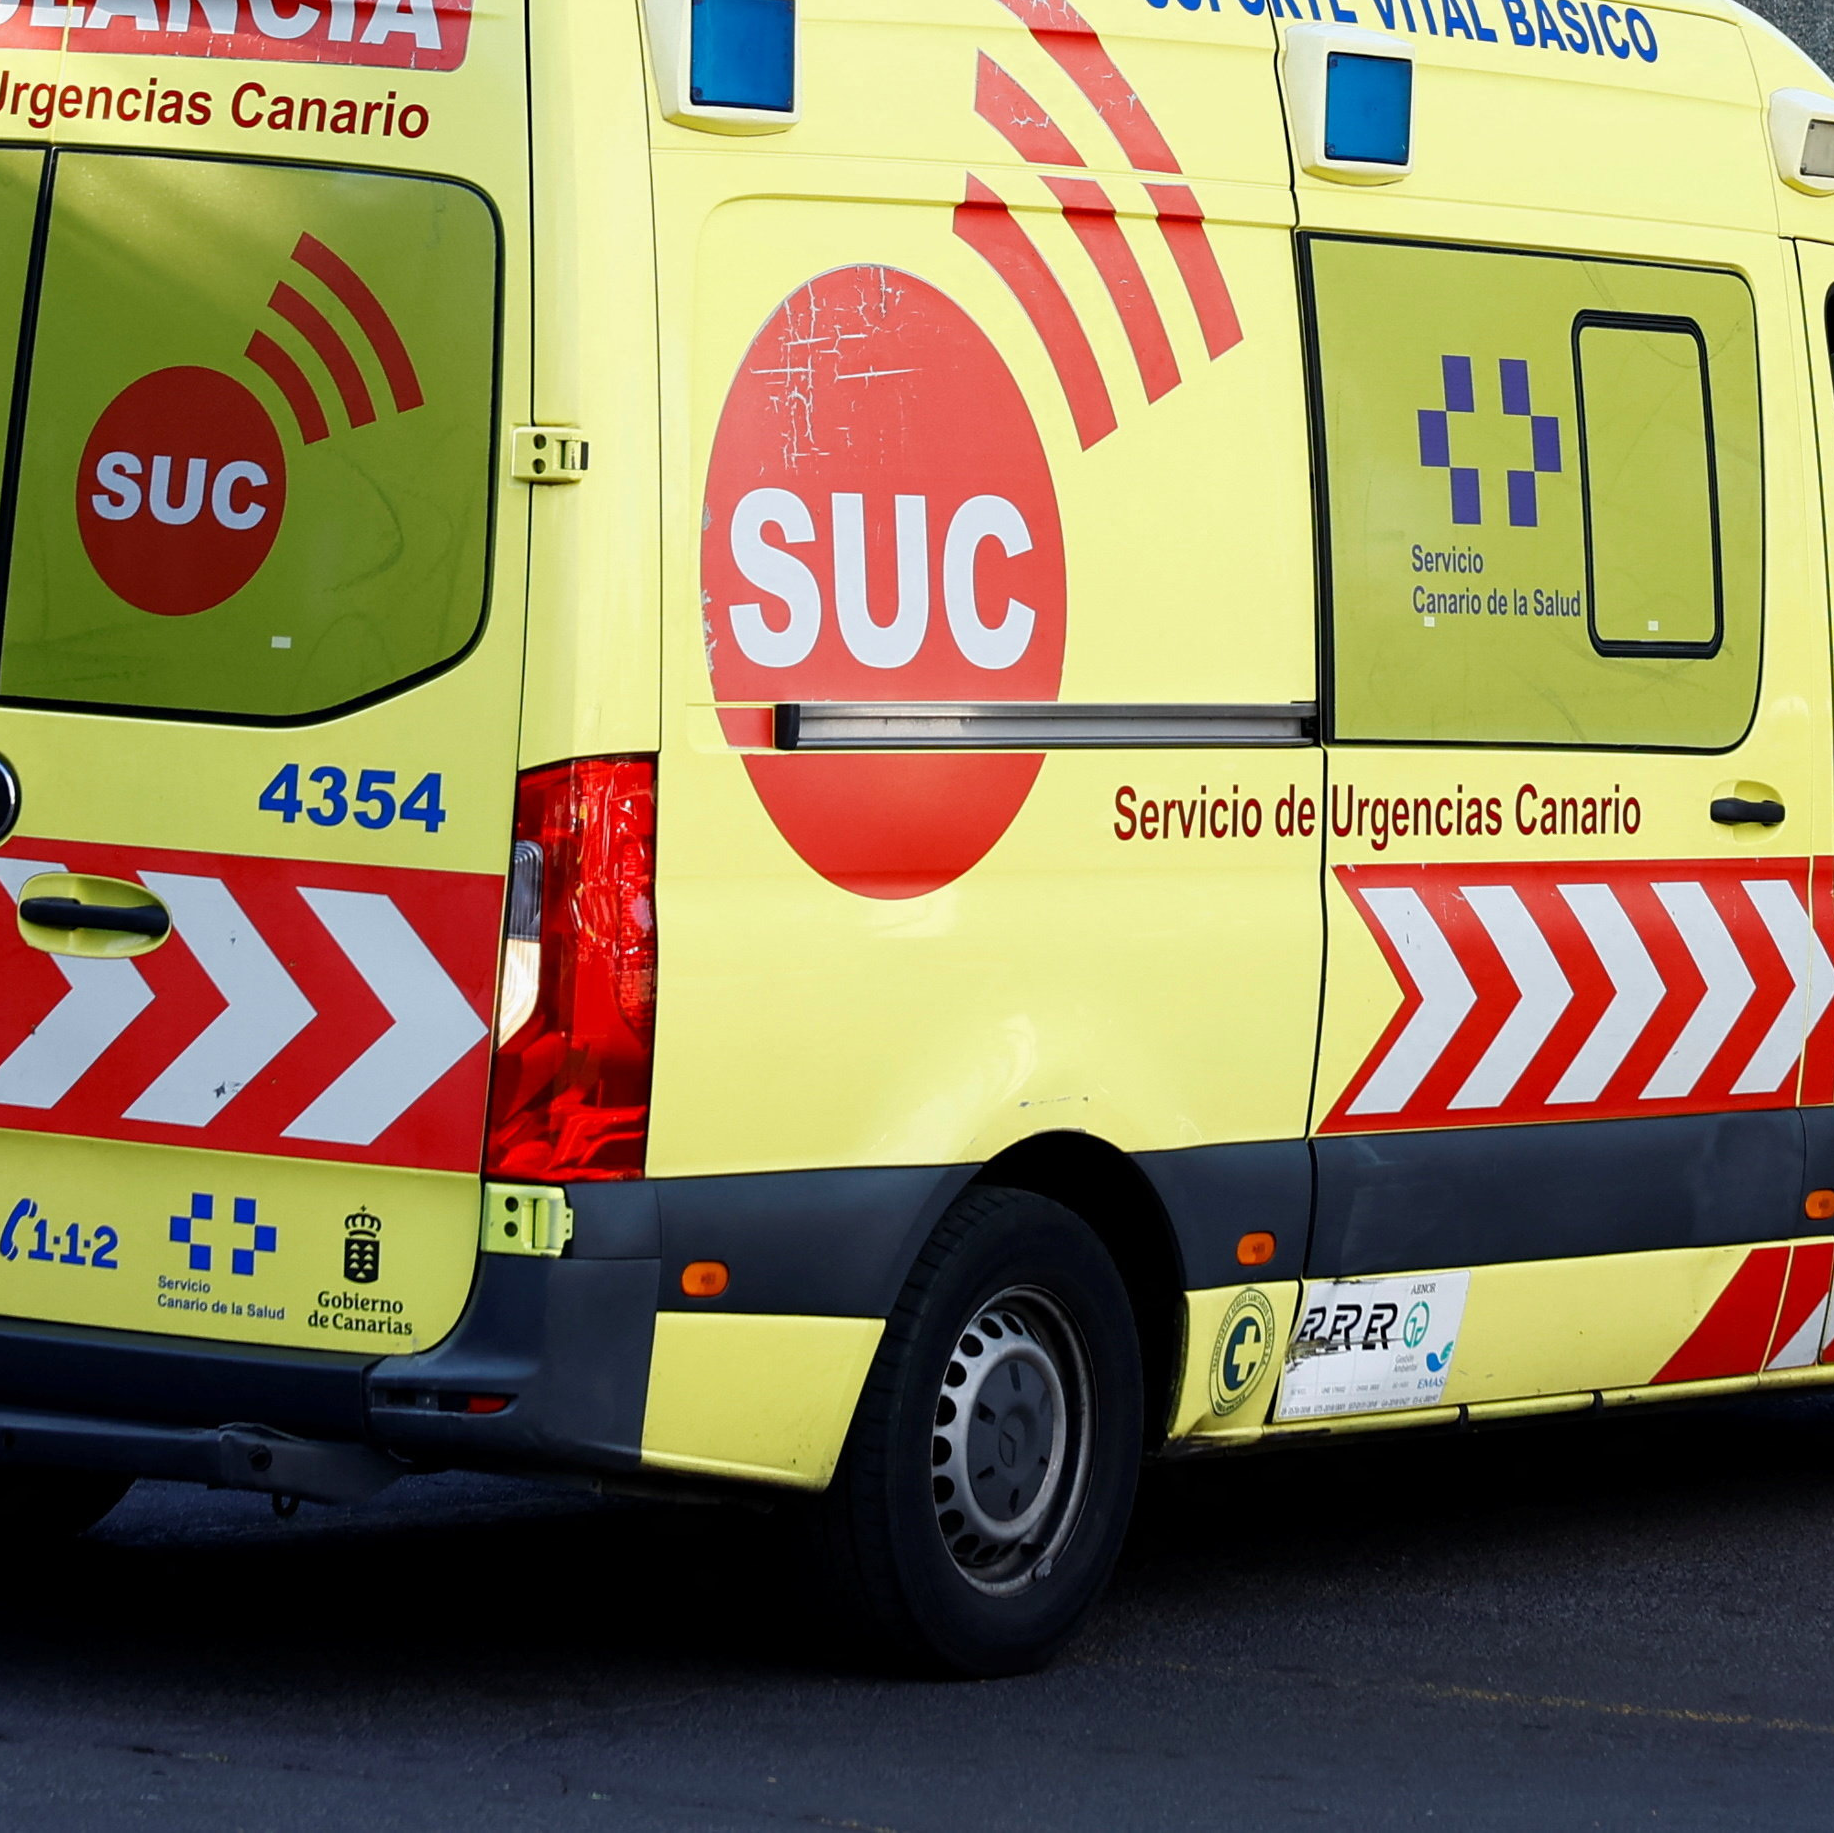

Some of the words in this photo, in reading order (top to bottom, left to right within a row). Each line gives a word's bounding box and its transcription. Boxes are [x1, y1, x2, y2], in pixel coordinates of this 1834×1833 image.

[230, 81, 431, 139] Canario
[91, 450, 268, 531] SUC
[1410, 543, 1484, 576] Servicio
[727, 487, 1037, 671] SUC
[1411, 585, 1481, 618] Canario
[1486, 587, 1508, 618] de
[1513, 587, 1528, 618] la
[1532, 588, 1582, 619] Salud
[258, 763, 447, 834] 4354
[1113, 783, 1263, 842] Servicio
[1273, 782, 1316, 838] de
[1329, 781, 1503, 852] Urgencias
[1513, 783, 1642, 837] Canario
[157, 1274, 211, 1295] Servicio
[157, 1293, 208, 1313] Canario
[211, 1299, 229, 1315] de
[231, 1301, 244, 1317] la
[247, 1302, 286, 1321] Salud
[317, 1290, 404, 1314] Gobierno
[308, 1310, 330, 1328] de
[332, 1313, 413, 1336] Canarias
[1417, 1376, 1444, 1390] EMAS
